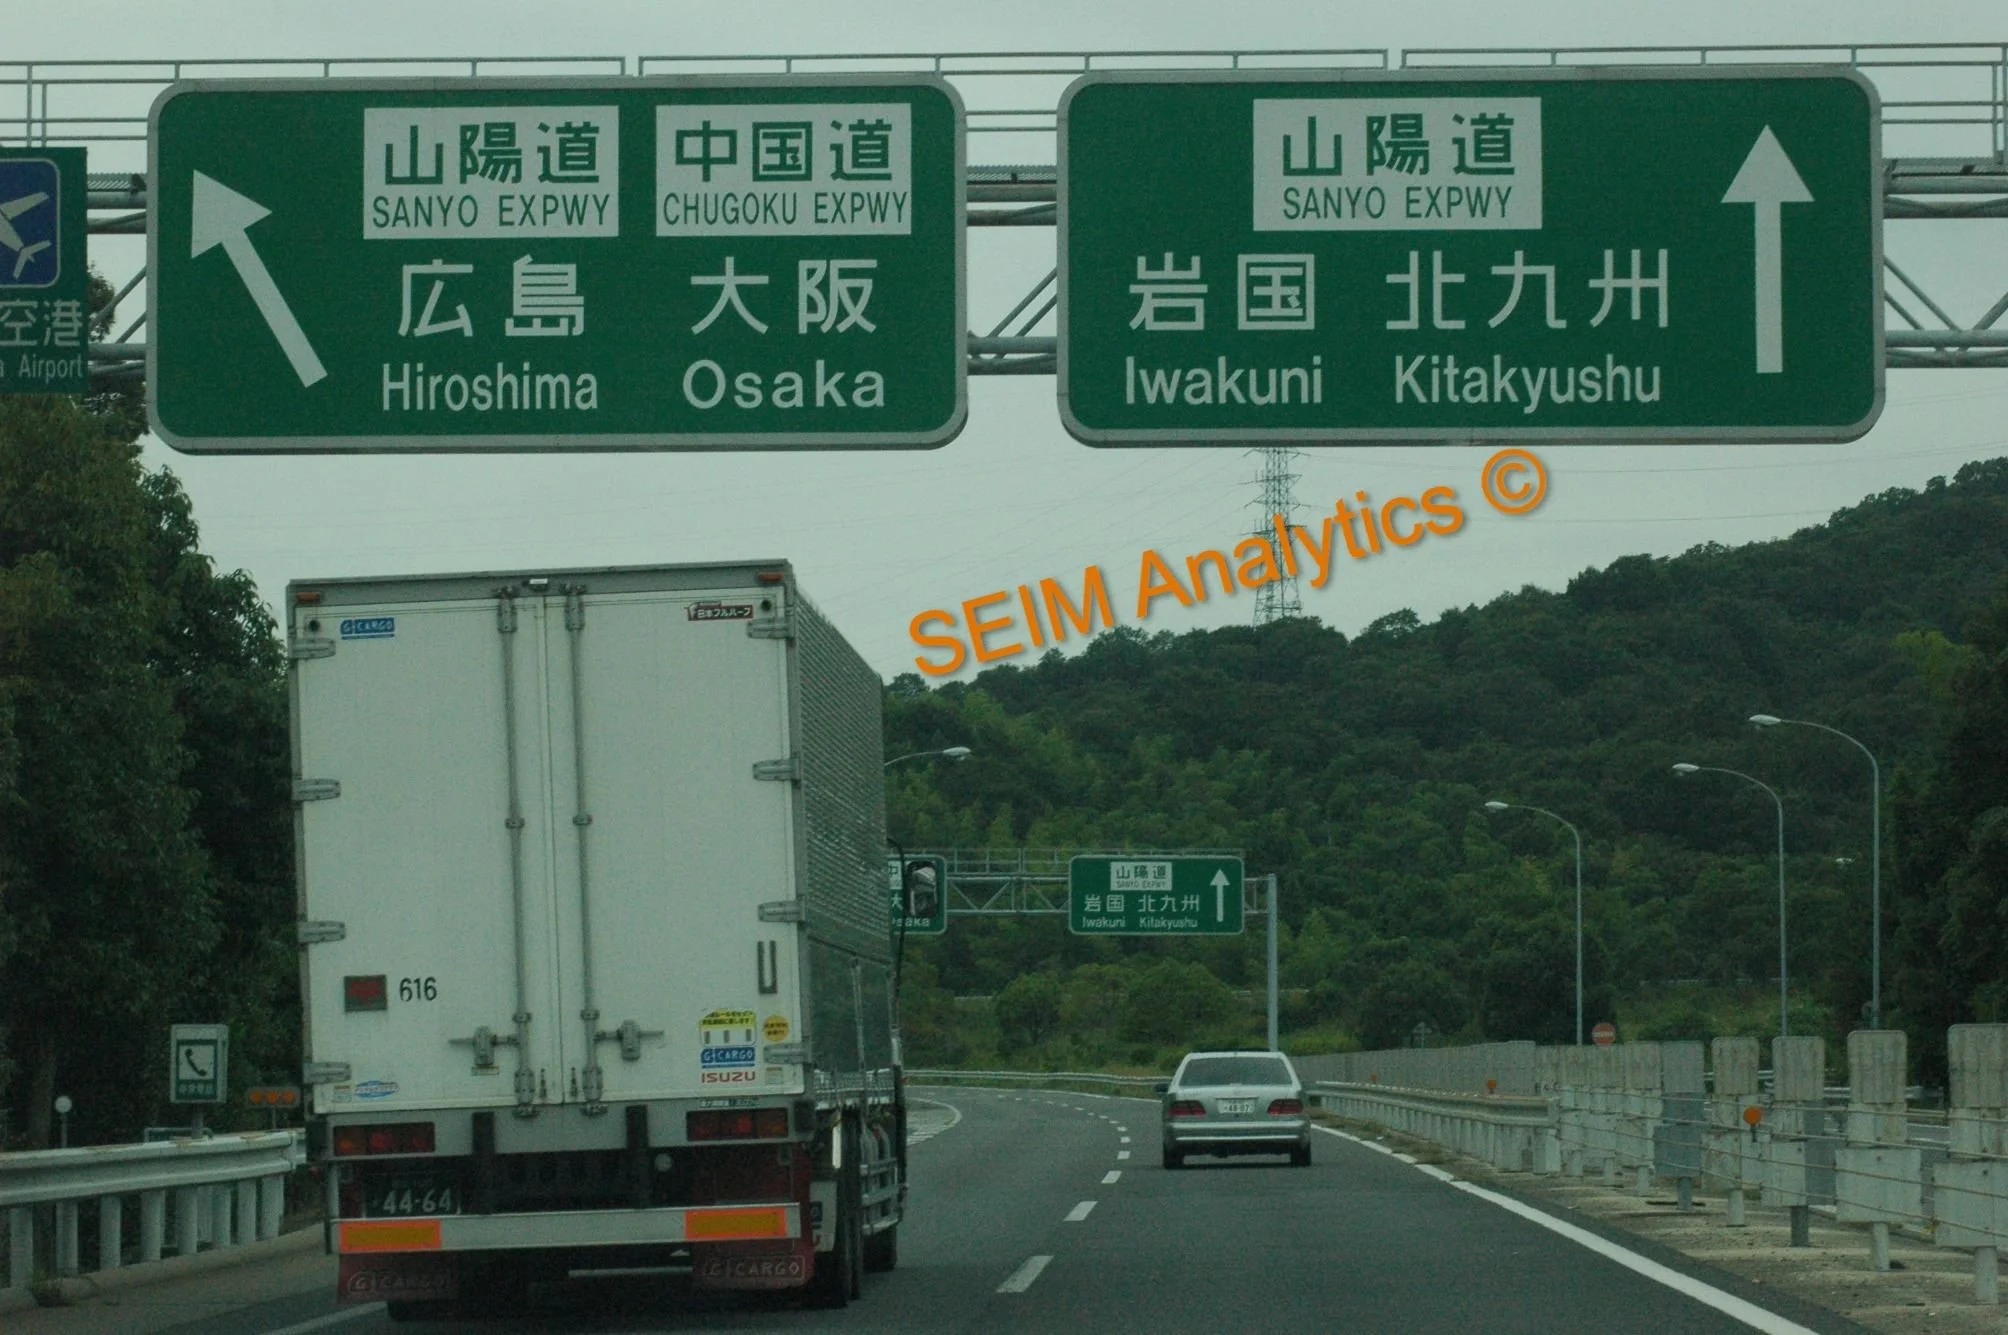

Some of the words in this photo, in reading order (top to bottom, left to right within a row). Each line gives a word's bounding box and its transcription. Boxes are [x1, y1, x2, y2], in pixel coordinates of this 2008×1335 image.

[385, 122, 600, 185] 山陽道
[675, 119, 893, 182] 中国道
[1283, 114, 1514, 177] 山陽道
[373, 195, 478, 227] SANYO
[499, 194, 610, 226] EXPWY
[664, 192, 797, 225] CHUGOKU
[814, 191, 907, 224] EXPWY
[1284, 186, 1386, 220] SANYO
[1405, 186, 1512, 219] EXPWY
[398, 255, 585, 337] 広島
[690, 257, 878, 334] 大阪
[1129, 251, 1316, 331] 岩国
[1386, 249, 1669, 330] 北九州
[19, 353, 83, 385] Airport
[383, 362, 597, 412] Hiroshima
[683, 360, 885, 409] Osaka
[1126, 355, 1322, 406] Iwakuni
[1395, 354, 1661, 414] Kitakyushu
[1084, 894, 1125, 912] 岩国
[1137, 894, 1200, 912] 北九州
[1082, 915, 1126, 928] Iwakuni
[1139, 916, 1198, 930] Kitakyushu
[399, 976, 438, 1002] 616
[702, 1071, 756, 1084] ISUZU
